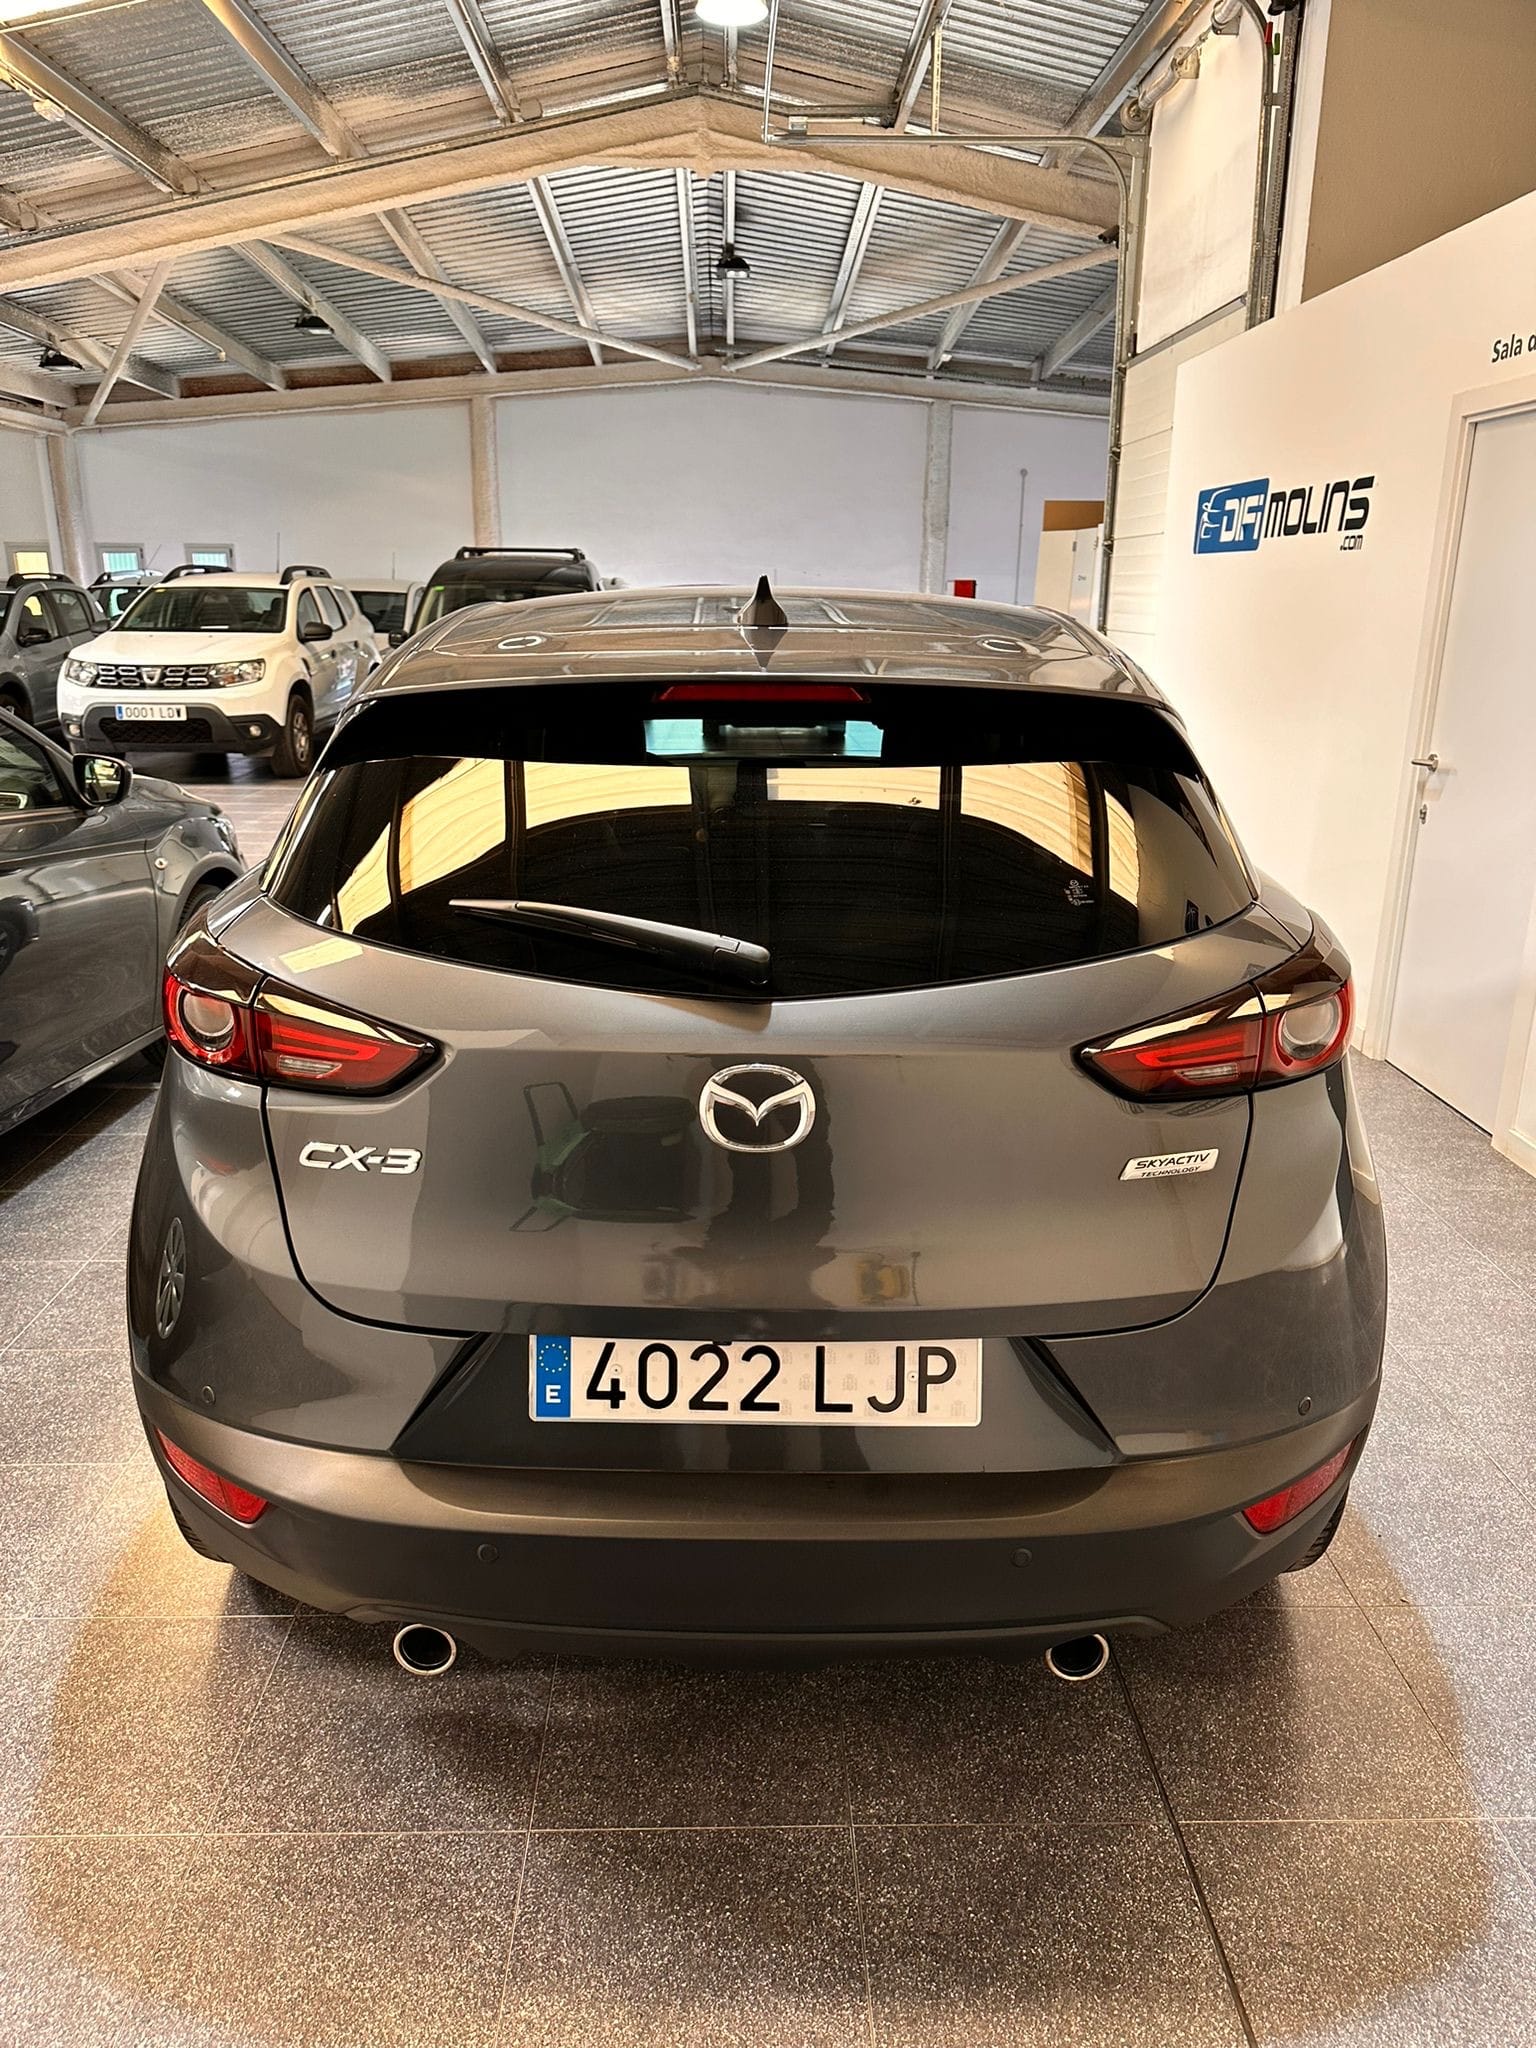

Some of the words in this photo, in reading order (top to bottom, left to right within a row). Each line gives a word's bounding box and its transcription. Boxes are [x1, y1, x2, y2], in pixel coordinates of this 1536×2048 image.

[1491, 333, 1522, 363] Sala
[125, 707, 154, 718] 0001
[299, 1141, 422, 1175] CX-3
[1134, 1152, 1211, 1170] SKYACTIV
[1140, 1165, 1201, 1178] TECHNOLOGY
[545, 1384, 562, 1404] E
[586, 1341, 781, 1412] 4022
[815, 1345, 957, 1413] LJP
